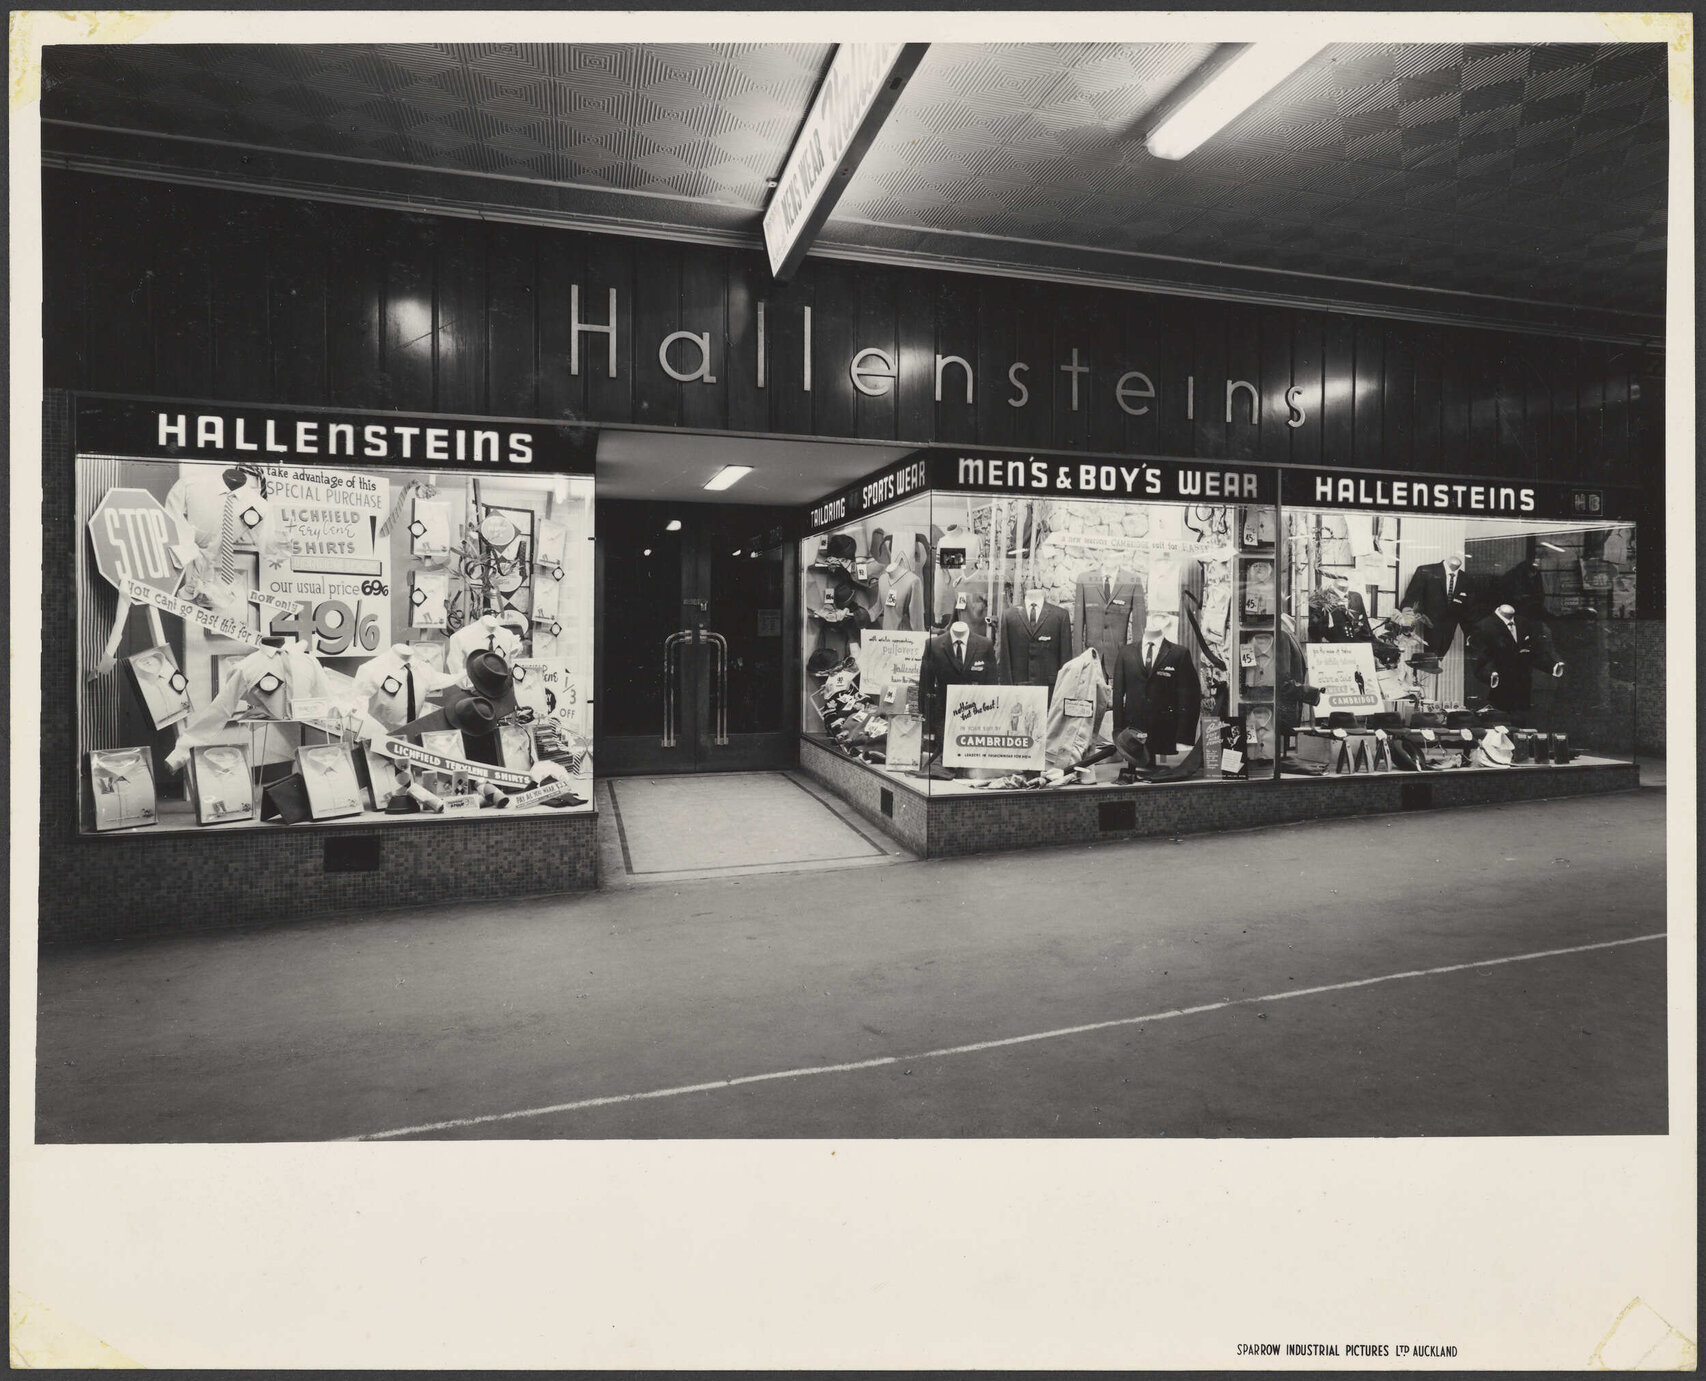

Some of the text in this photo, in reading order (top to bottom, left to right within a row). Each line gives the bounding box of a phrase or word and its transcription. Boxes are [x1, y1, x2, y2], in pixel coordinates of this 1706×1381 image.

[571, 284, 1306, 428] Hallensteins
[158, 413, 533, 464] HALLENSTEINS
[267, 467, 377, 491] take advantage of this
[811, 497, 846, 528] TAILORING
[862, 474, 894, 509] SPORTS
[896, 460, 926, 495] WEAR
[1056, 466, 1072, 489] &
[1079, 463, 1161, 494] BOY'S
[1179, 470, 1258, 498] WEAR
[1315, 476, 1535, 511] HALLENSTEINS
[267, 481, 382, 509] SPECIAL PURCHASE
[281, 508, 361, 524] LICHFIELD
[104, 507, 171, 580] STOP
[291, 541, 356, 555] SHIRTS
[270, 581, 293, 594] our
[296, 576, 325, 595] usual
[328, 580, 360, 600] price
[180, 604, 193, 618] go
[220, 617, 237, 635] this
[238, 625, 252, 643] for
[560, 707, 576, 719] OFF
[1332, 695, 1376, 705] CAMBRIDGE
[960, 736, 1029, 748] CAMBRIDGE
[393, 744, 531, 784] LICHFIELD TERYLENE SHIRTS
